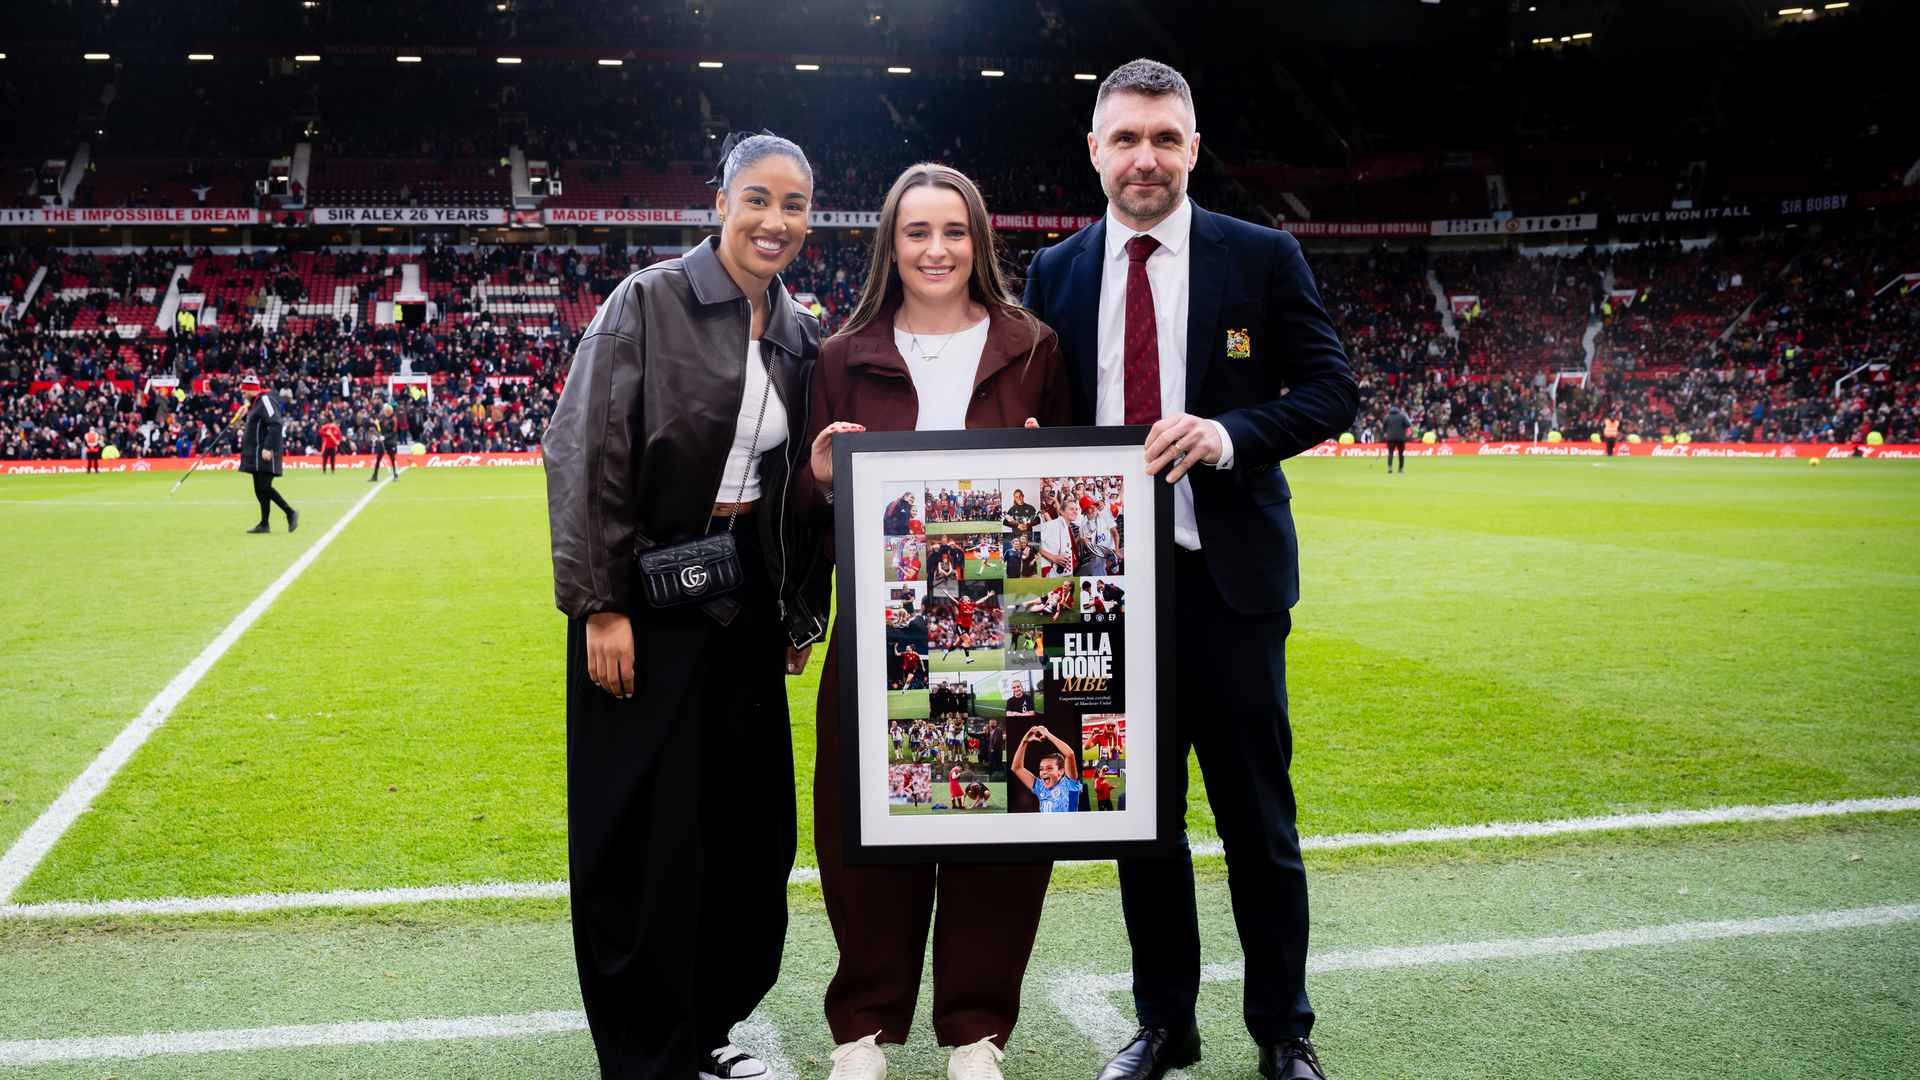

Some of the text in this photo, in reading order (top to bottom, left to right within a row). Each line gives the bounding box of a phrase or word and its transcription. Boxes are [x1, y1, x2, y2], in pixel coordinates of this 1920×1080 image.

[1781, 199, 1802, 214] SIR
[1806, 194, 1848, 212] BOBBY
[42, 209, 250, 220] THE IMPOSSIBLE DREAM
[328, 209, 489, 221] SIR ALEX 26 YEARS
[552, 210, 598, 221] MADE
[1665, 209, 1700, 220] WON
[1704, 207, 1719, 217] IT
[1722, 204, 1751, 216] ALL
[996, 214, 1035, 227] SINGLE
[1037, 216, 1059, 227] ONE
[1061, 216, 1075, 227] OF
[1382, 223, 1428, 232] FOOTBALL
[1064, 632, 1112, 656] ELLA
[1050, 656, 1113, 680] TOONE
[1061, 676, 1108, 692] MBE
